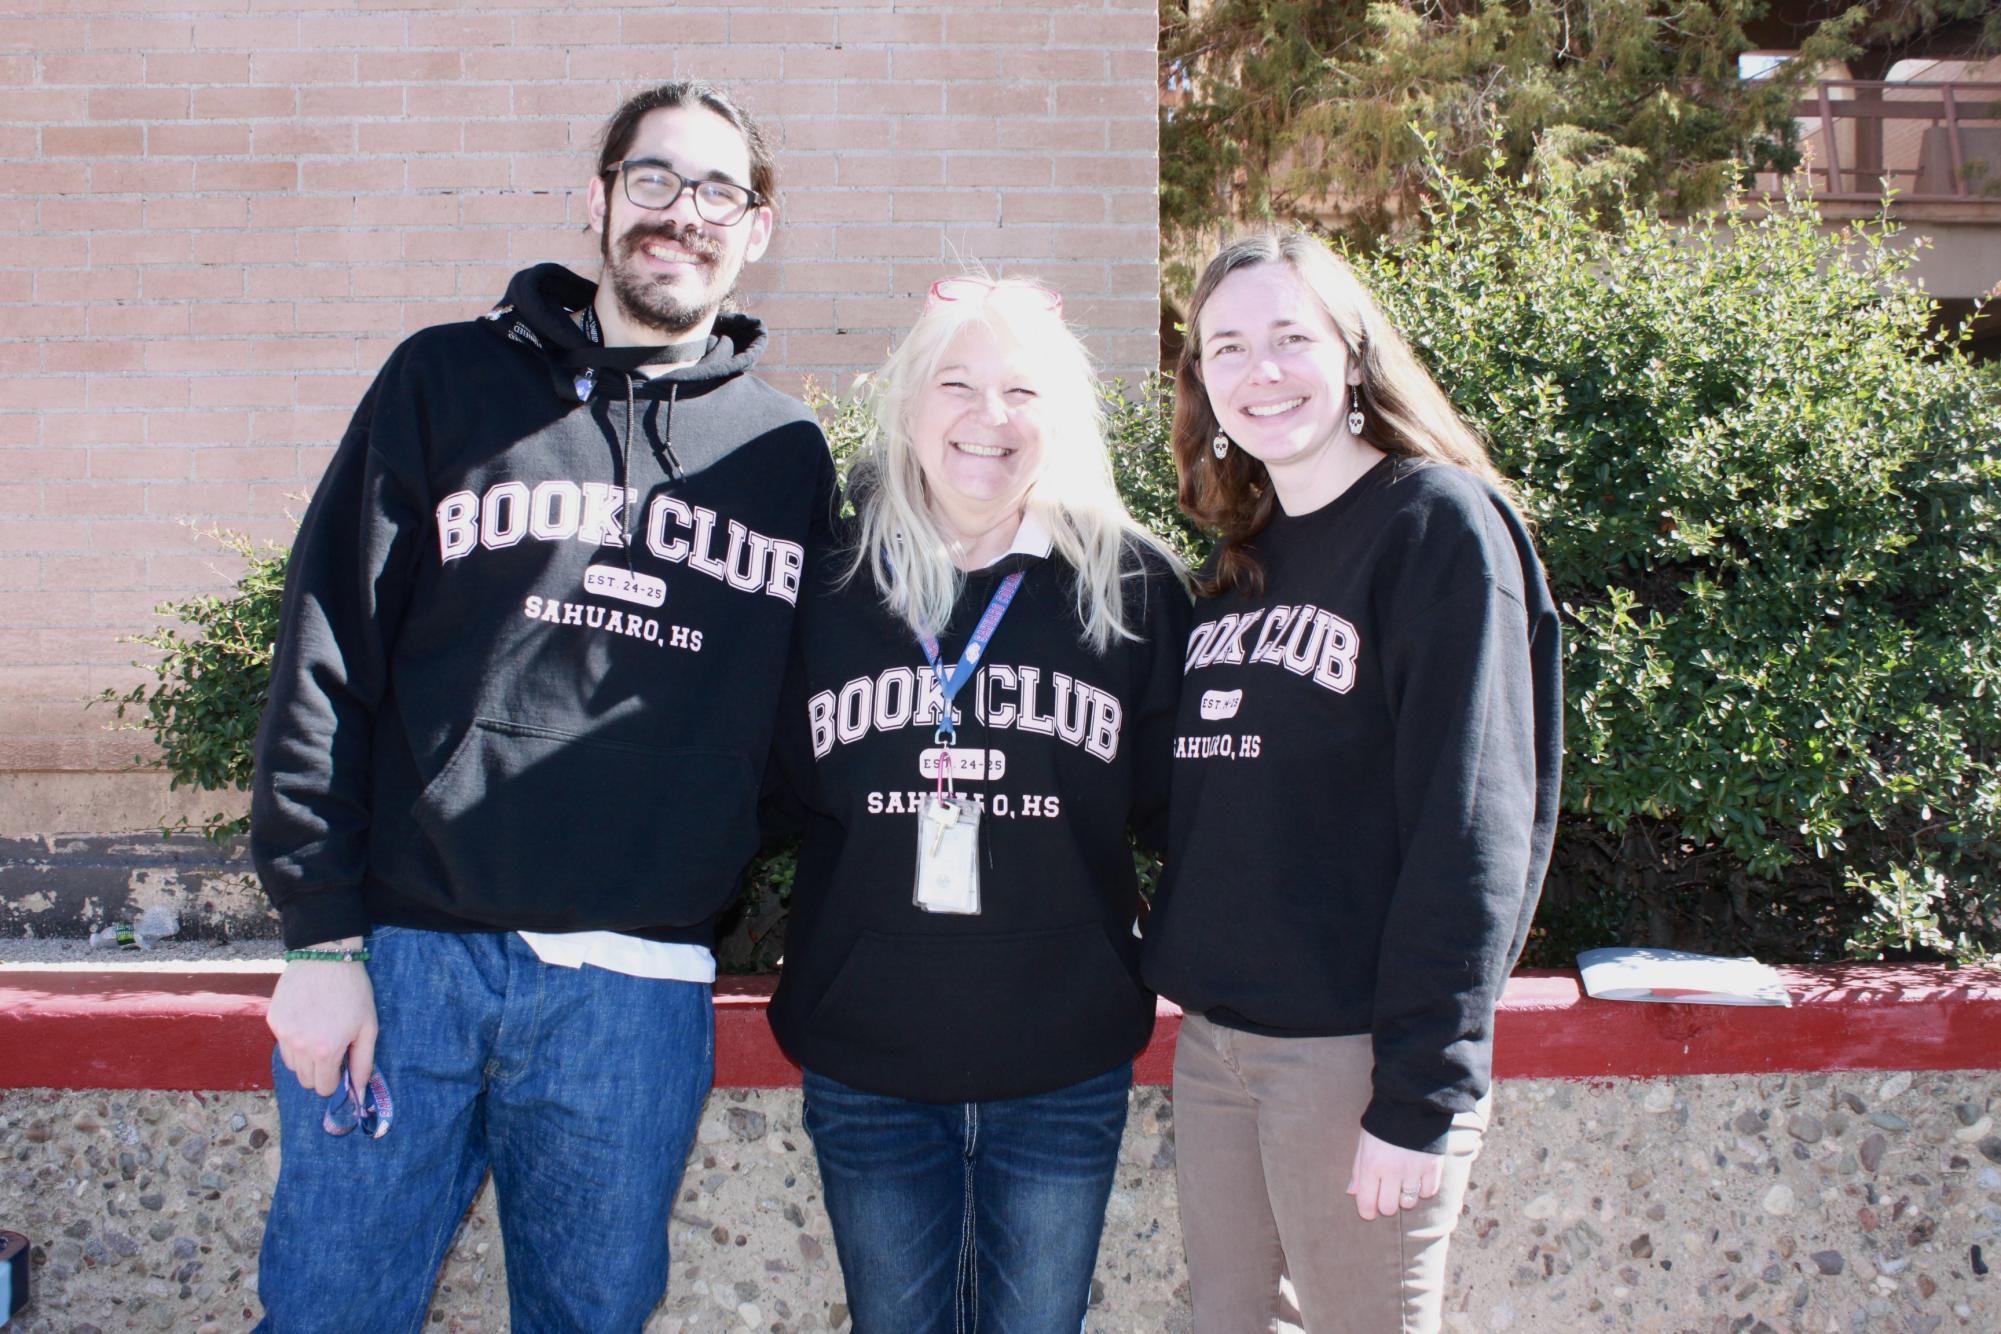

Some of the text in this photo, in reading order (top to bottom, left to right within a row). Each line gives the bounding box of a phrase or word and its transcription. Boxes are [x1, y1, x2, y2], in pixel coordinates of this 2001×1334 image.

[436, 480, 804, 608] BOOK CLUB
[587, 574, 663, 600] EST. 24-25
[524, 595, 704, 653] SAHUARO, HS
[1183, 604, 1361, 695] OOK CLUB
[808, 664, 1123, 764] BOOK CLUB
[1238, 734, 1262, 758] HS
[1021, 794, 1060, 819] HS
